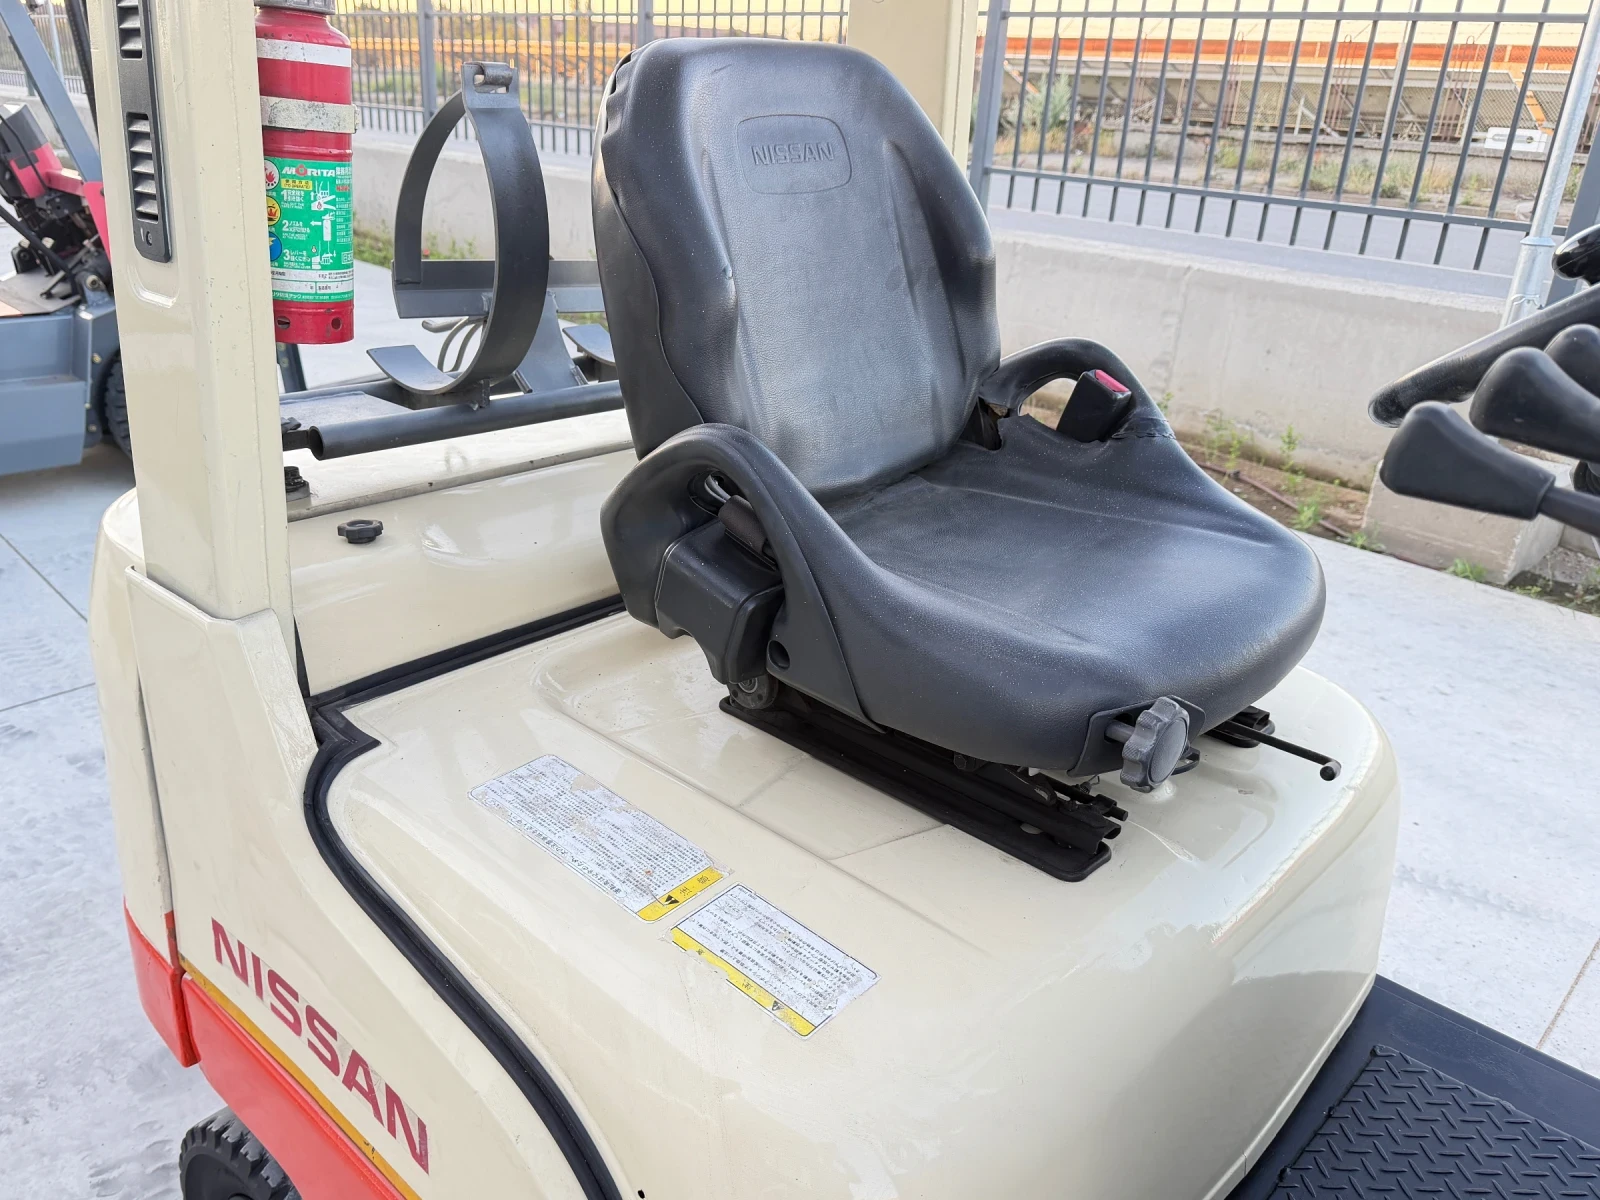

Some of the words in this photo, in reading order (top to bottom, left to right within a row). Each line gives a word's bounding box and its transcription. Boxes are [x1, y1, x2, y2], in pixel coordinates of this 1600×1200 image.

[751, 142, 834, 165] NISSAN
[282, 164, 336, 177] MORITA
[282, 219, 289, 231] 2
[283, 249, 290, 261] 3
[211, 917, 430, 1176] NISSAN
